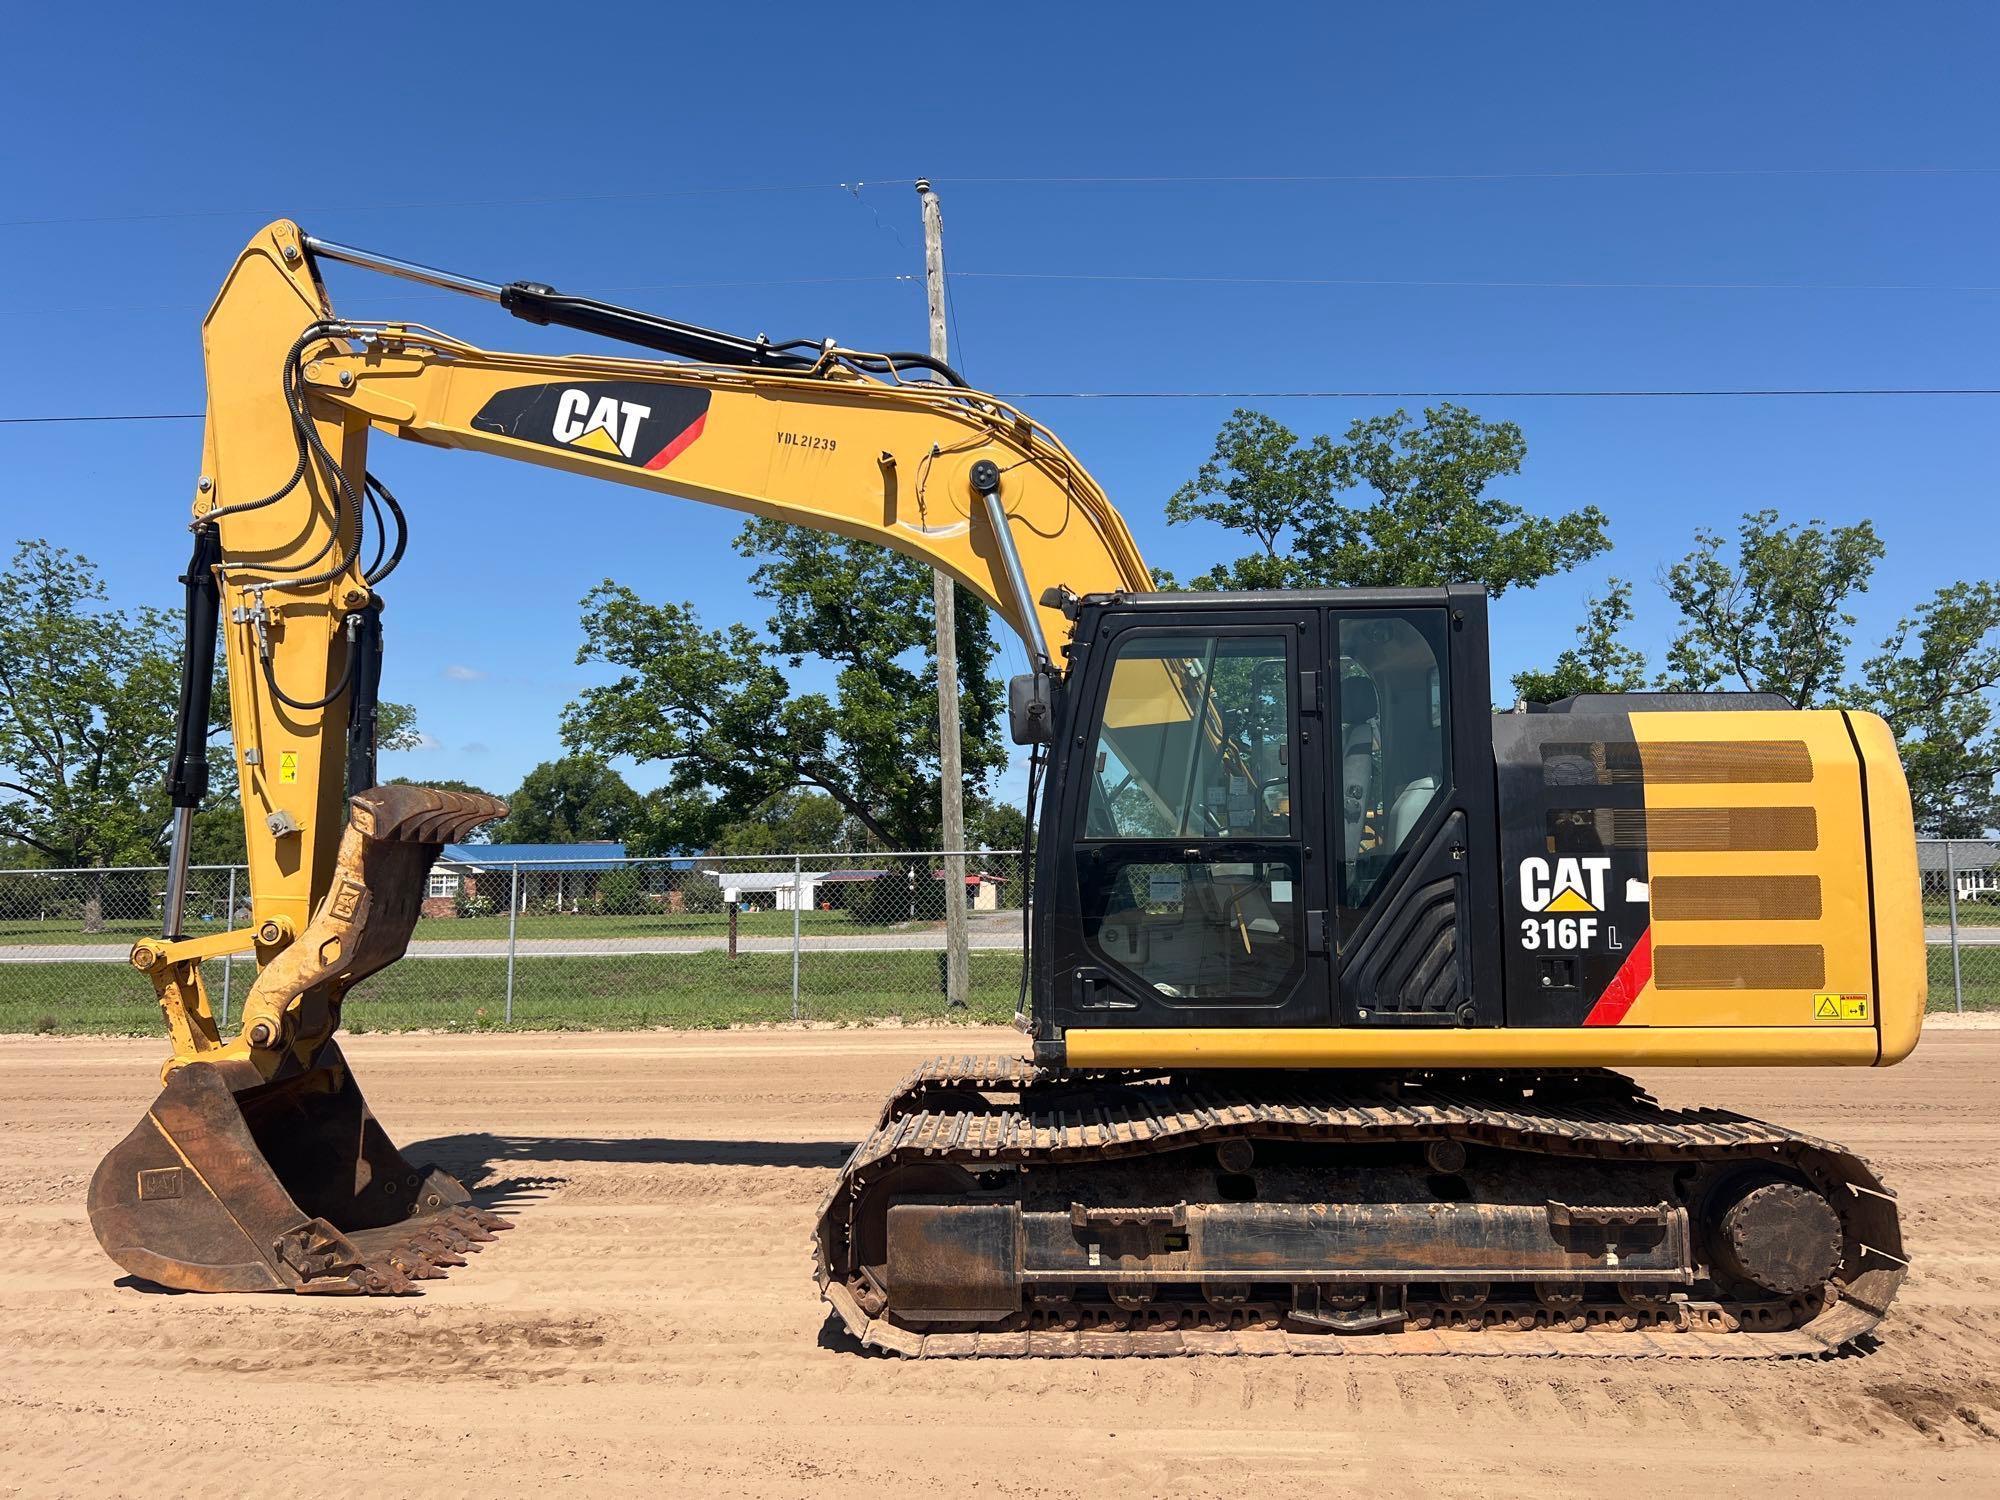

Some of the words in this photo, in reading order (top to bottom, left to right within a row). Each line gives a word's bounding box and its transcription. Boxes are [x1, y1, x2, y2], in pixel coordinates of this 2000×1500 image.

[552, 388, 652, 458] CAT
[777, 431, 837, 452] YDL21239
[332, 883, 361, 919] CAT
[1520, 857, 1611, 912] CAT
[1521, 918, 1597, 950] 316F
[1608, 926, 1622, 949] L
[146, 1172, 177, 1195] CAT
